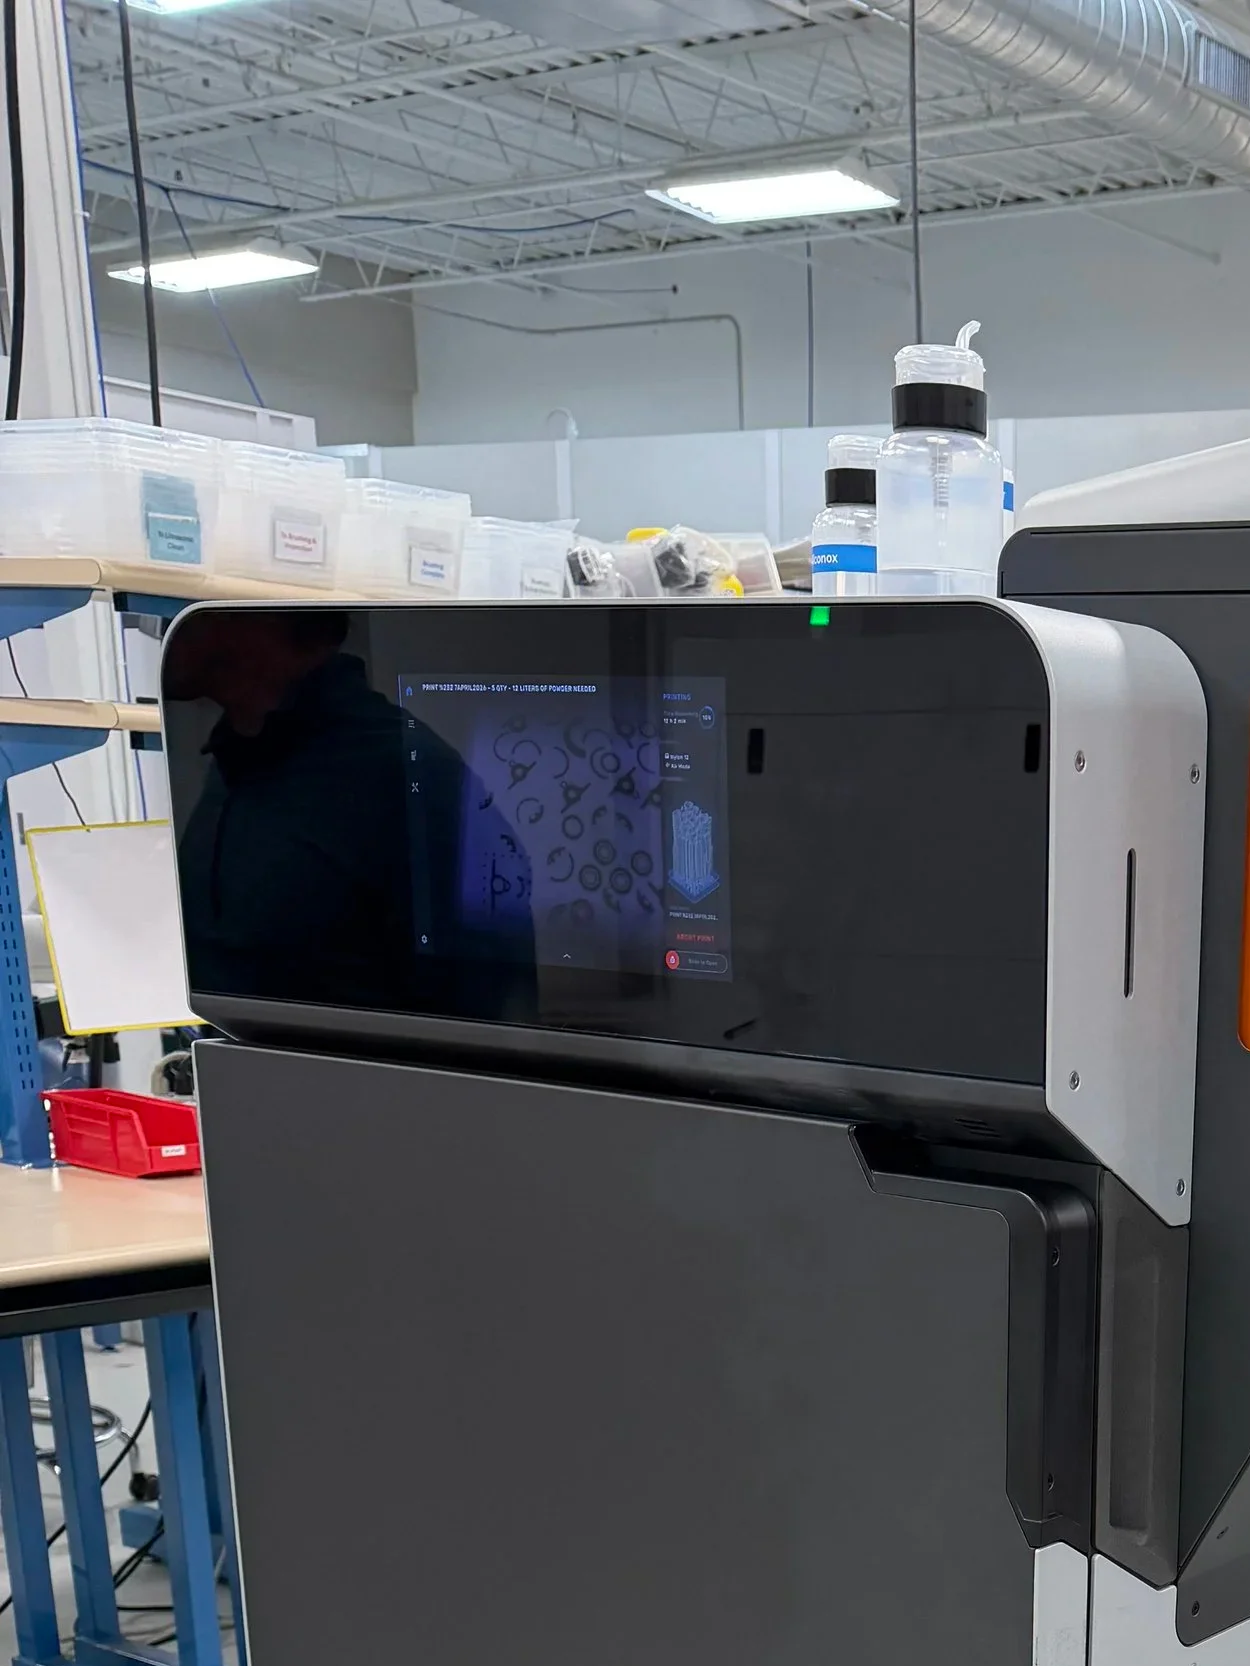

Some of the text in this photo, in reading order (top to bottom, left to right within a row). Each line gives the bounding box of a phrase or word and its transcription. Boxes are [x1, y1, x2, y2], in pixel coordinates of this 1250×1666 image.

[811, 553, 839, 565] lconox
[519, 684, 539, 692] LITERS
[540, 684, 548, 692] OF
[549, 684, 572, 693] POWDER
[573, 685, 597, 693] NEEDED
